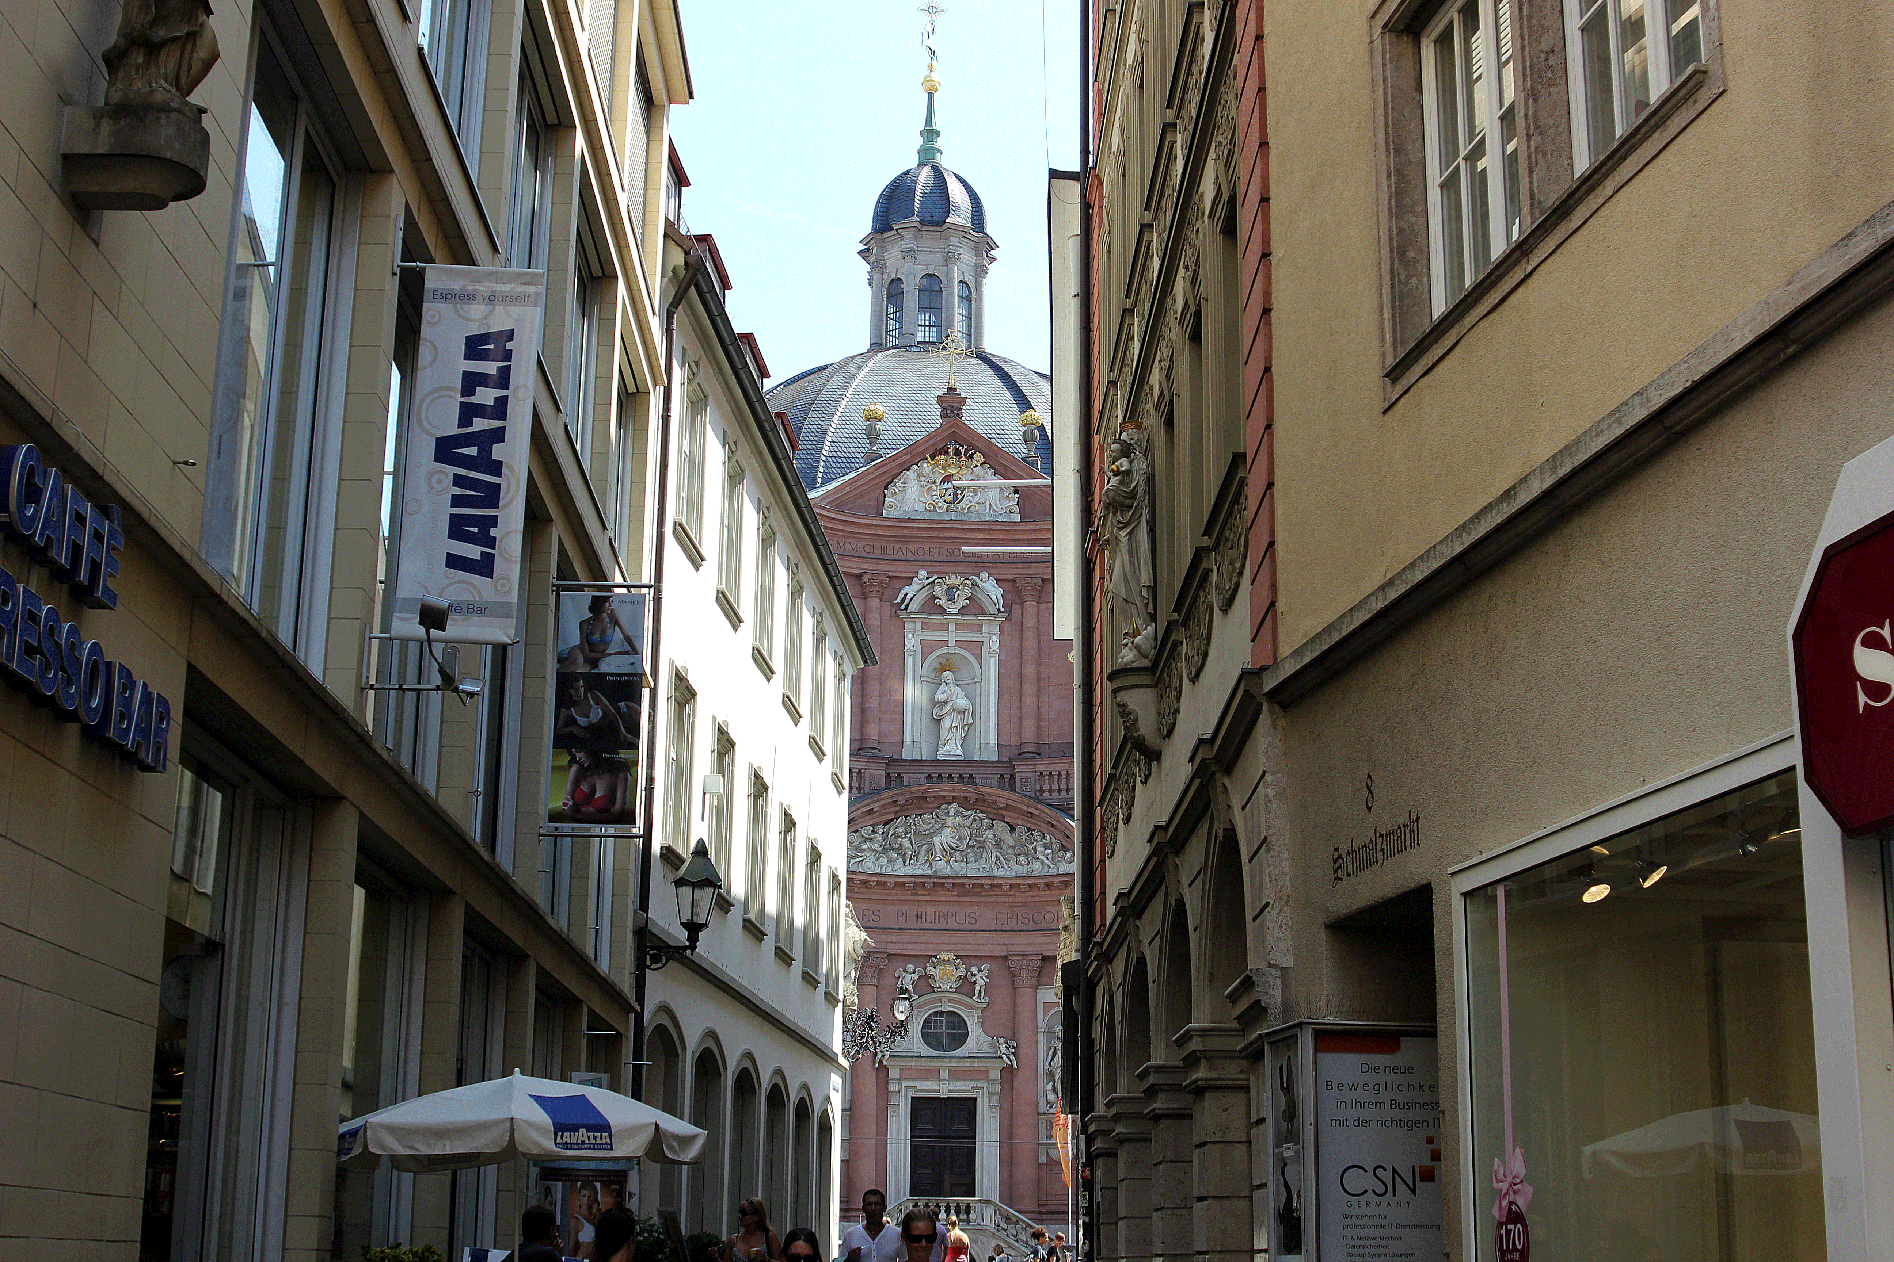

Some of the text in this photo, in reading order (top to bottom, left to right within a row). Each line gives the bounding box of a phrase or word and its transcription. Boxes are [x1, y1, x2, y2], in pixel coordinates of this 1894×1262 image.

[432, 289, 533, 304] Espress yourself.
[433, 327, 515, 580] LAVAZZA
[466, 603, 488, 615] Bar
[107, 660, 171, 773] BAR
[896, 909, 978, 925] PHILIPPUS
[1360, 1062, 1415, 1075] Die neue
[1325, 1080, 1437, 1095] Beweglichke
[1336, 1098, 1440, 1111] in Ihrem Business
[1330, 1117, 1350, 1128] mit
[1352, 1117, 1373, 1128] der
[1376, 1117, 1430, 1132] richtigen
[556, 1128, 611, 1144] LAVAZZA
[1339, 1164, 1417, 1198] CSN
[1346, 1200, 1412, 1208] GERMANY
[1500, 1223, 1524, 1250] 170
